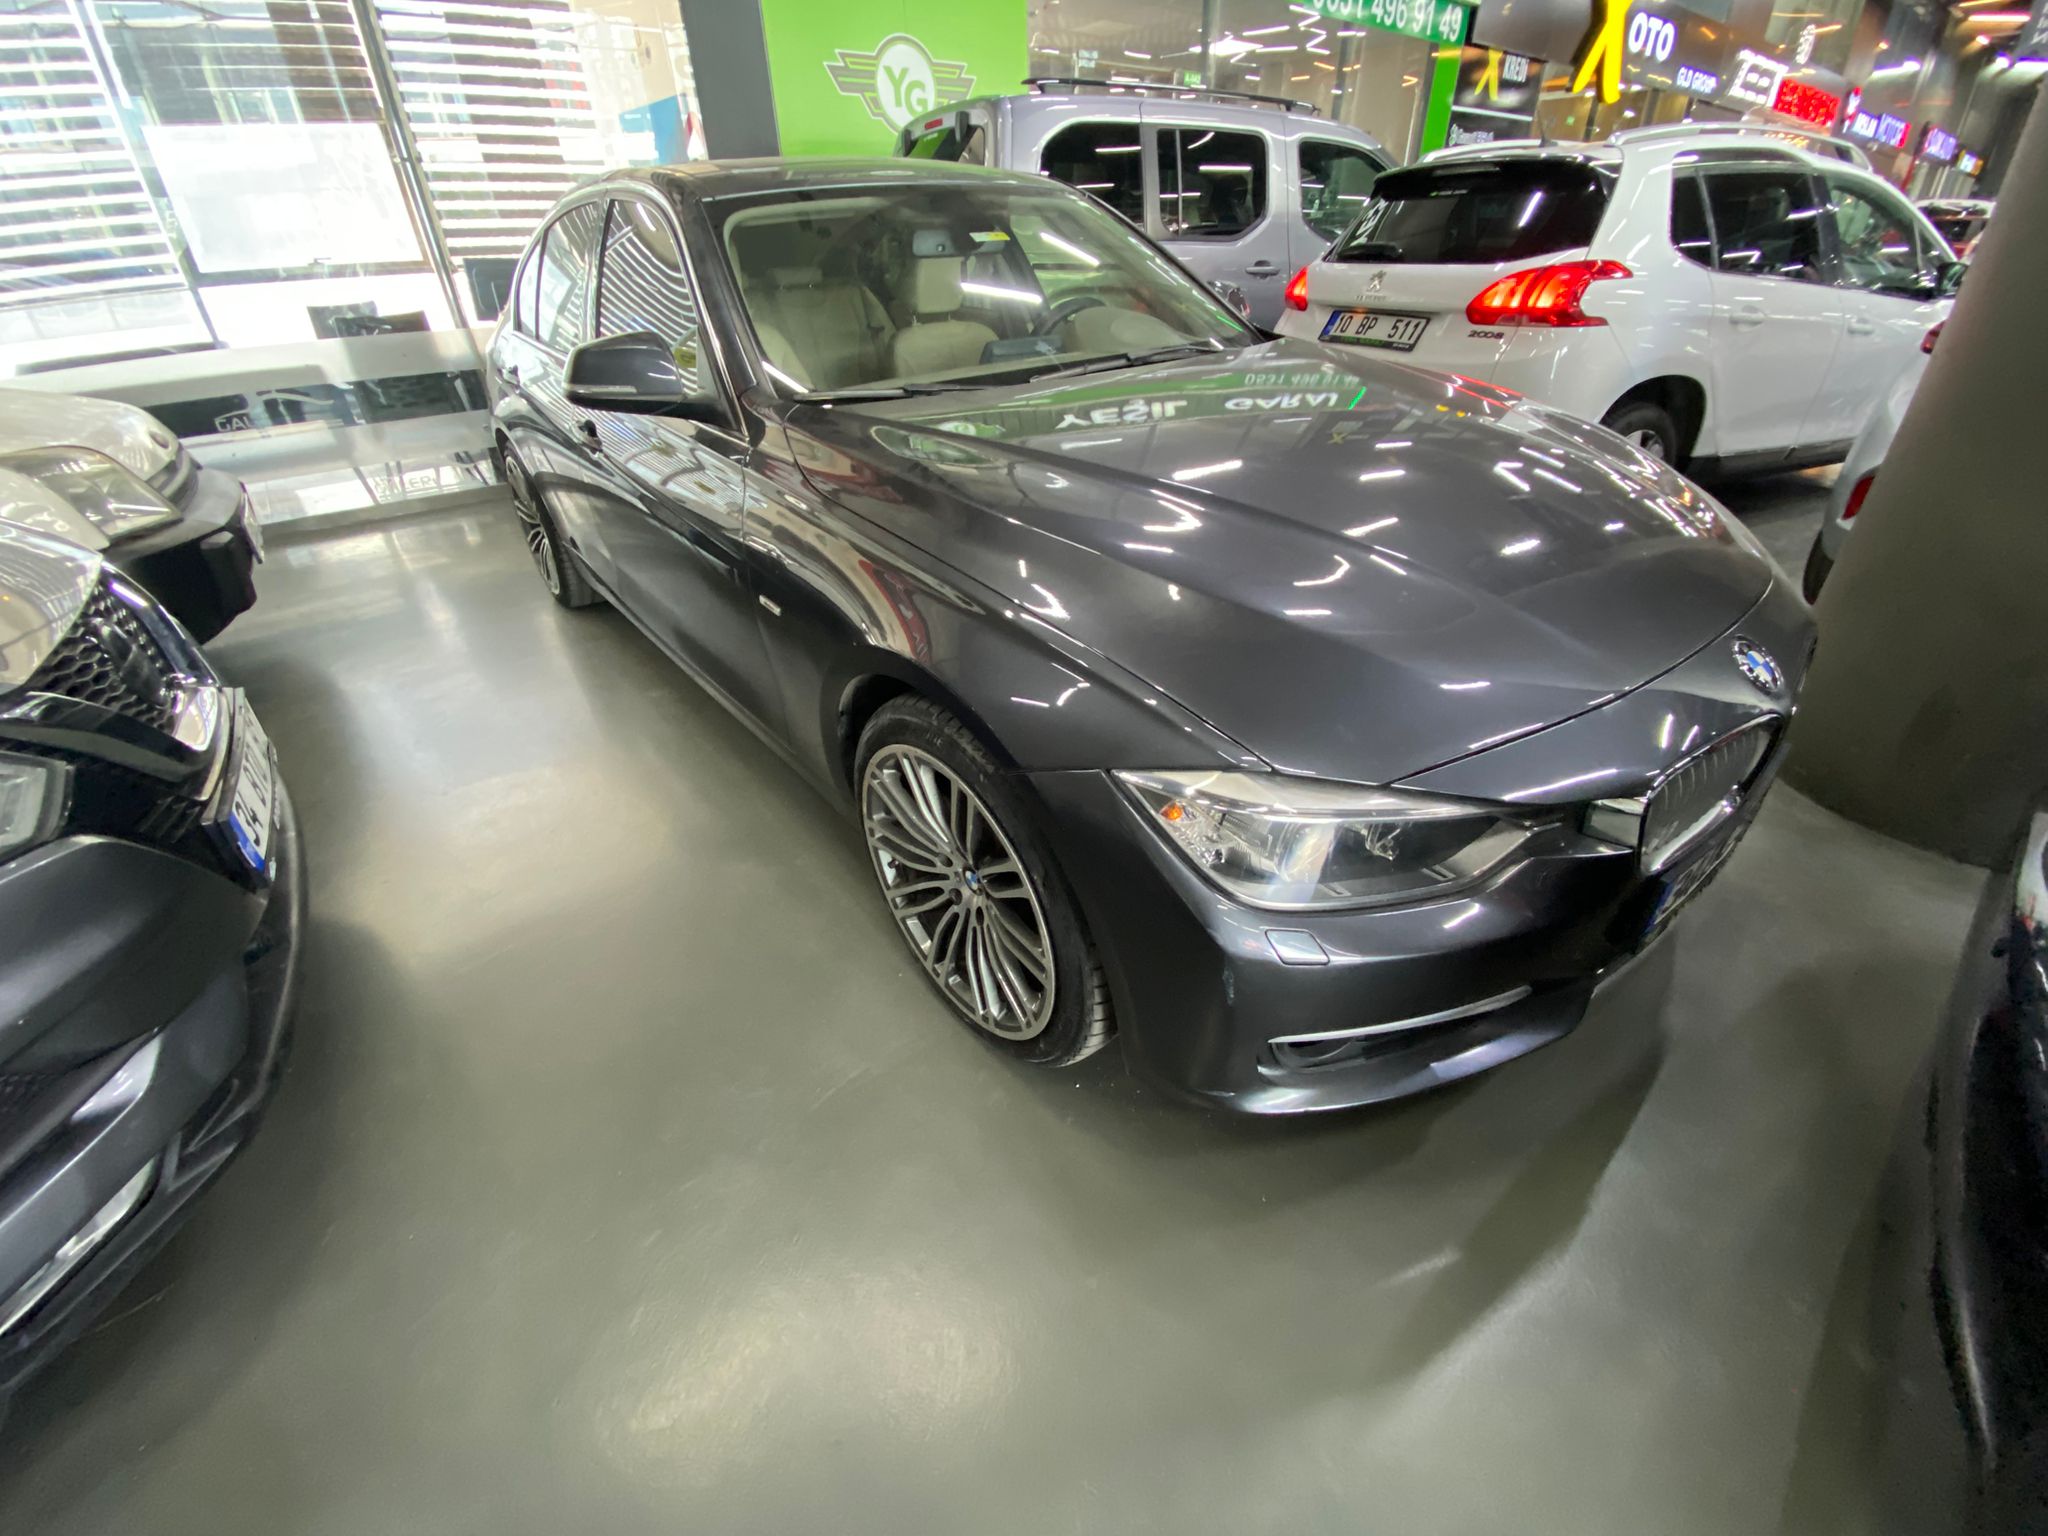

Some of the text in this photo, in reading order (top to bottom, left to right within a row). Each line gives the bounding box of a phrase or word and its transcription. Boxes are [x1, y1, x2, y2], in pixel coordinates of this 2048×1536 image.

[1371, 0, 1408, 29] 496
[1412, 0, 1435, 36] 91
[1438, 5, 1463, 42] 49
[1628, 12, 1675, 62] OTO
[1335, 315, 1353, 334] 10
[1355, 316, 1378, 336] BP
[1388, 319, 1421, 342] 511
[1467, 329, 1505, 340] 2008
[235, 789, 264, 848] 34
